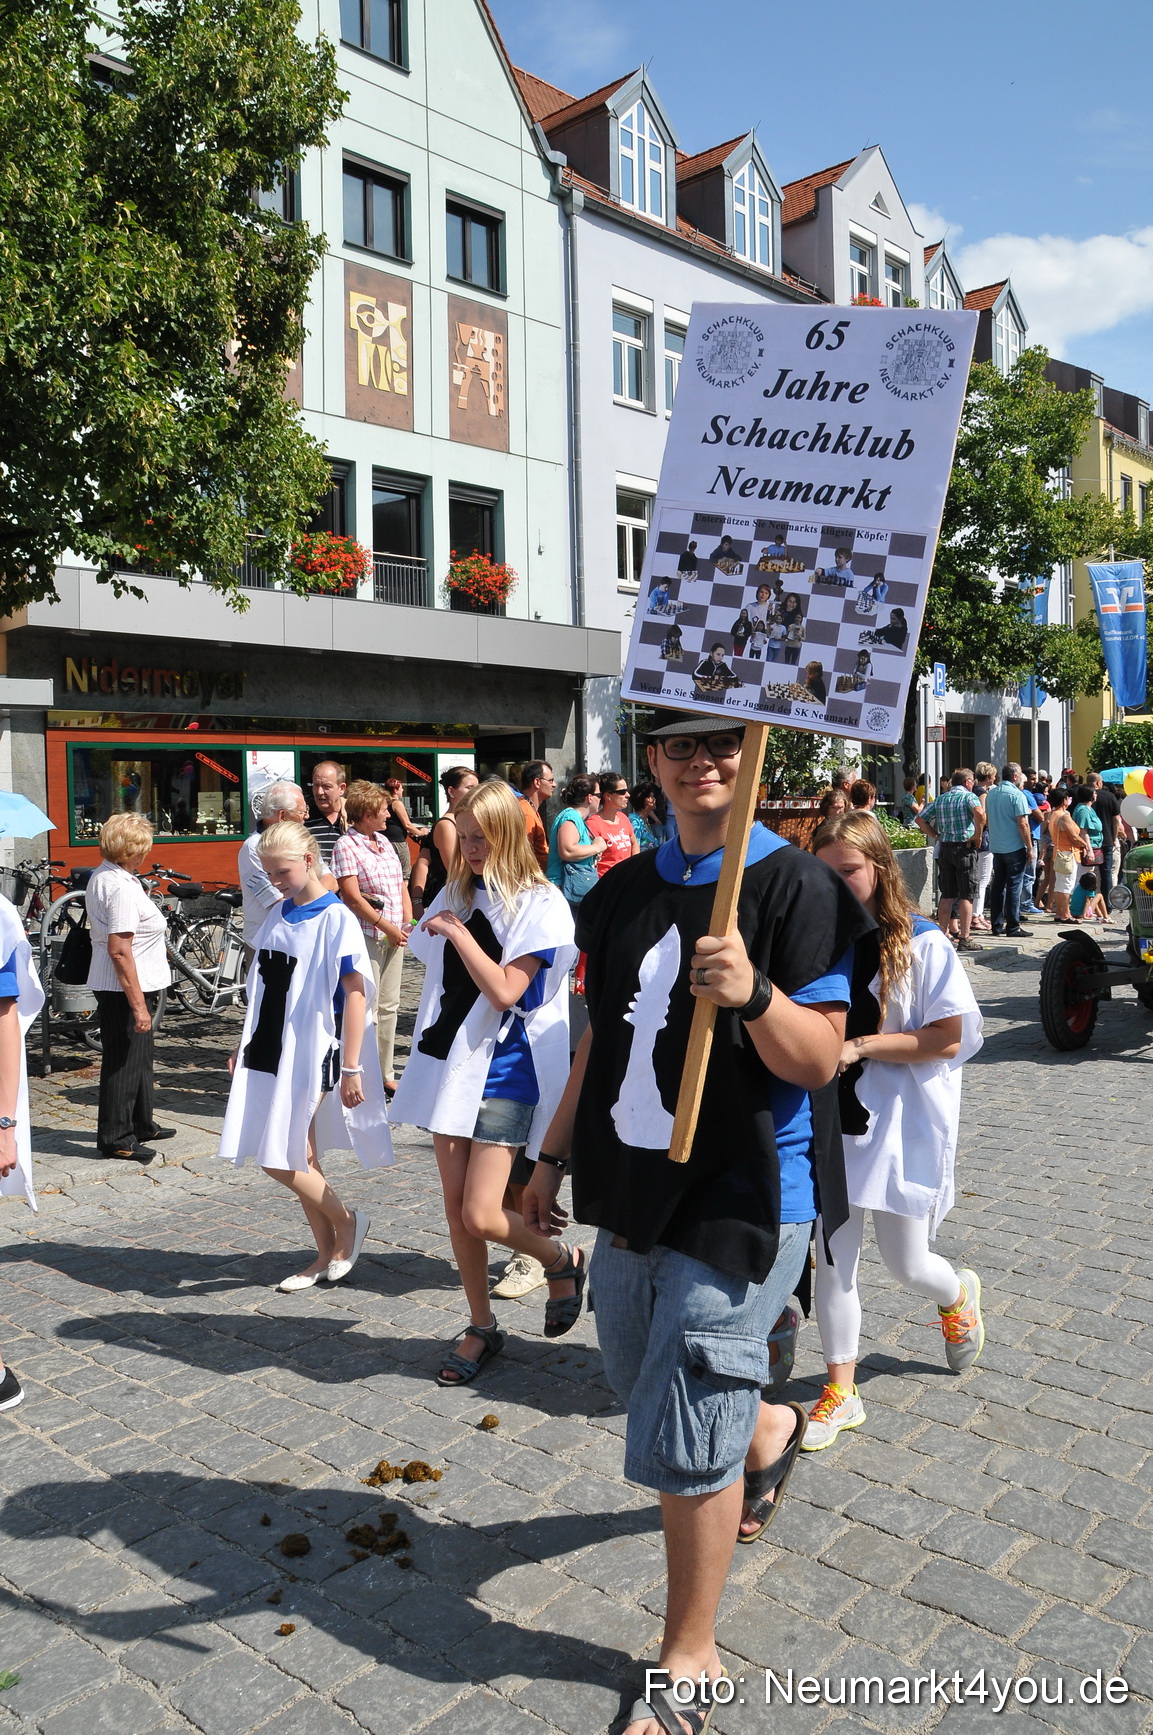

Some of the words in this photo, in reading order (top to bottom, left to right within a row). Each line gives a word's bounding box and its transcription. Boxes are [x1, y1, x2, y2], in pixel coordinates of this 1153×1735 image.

[702, 316, 764, 342] SCHACHKLUB
[805, 319, 851, 351] 65
[885, 323, 955, 352] SCHACHKLUB
[696, 358, 745, 389] NEUMARKT
[747, 362, 761, 377] E.V.
[763, 368, 870, 404] Jahre
[879, 368, 934, 401] NEUMARKT
[936, 373, 952, 389] E.V.
[701, 415, 916, 461] Schachklub
[706, 465, 892, 511] Neumarkt
[695, 513, 750, 527] Unterstützen
[752, 519, 766, 528] Sie
[768, 521, 818, 534] Neumarkts
[820, 526, 854, 539] klügste
[856, 530, 888, 542] Köpfe!
[936, 667, 943, 693] P
[640, 682, 671, 695] Werden
[674, 688, 687, 697] Sie
[689, 690, 726, 703] Sponsor
[726, 697, 741, 706] der
[742, 699, 775, 712] Jugend
[777, 704, 792, 714] des
[794, 707, 809, 718] SK
[811, 710, 859, 726] Neumarkt
